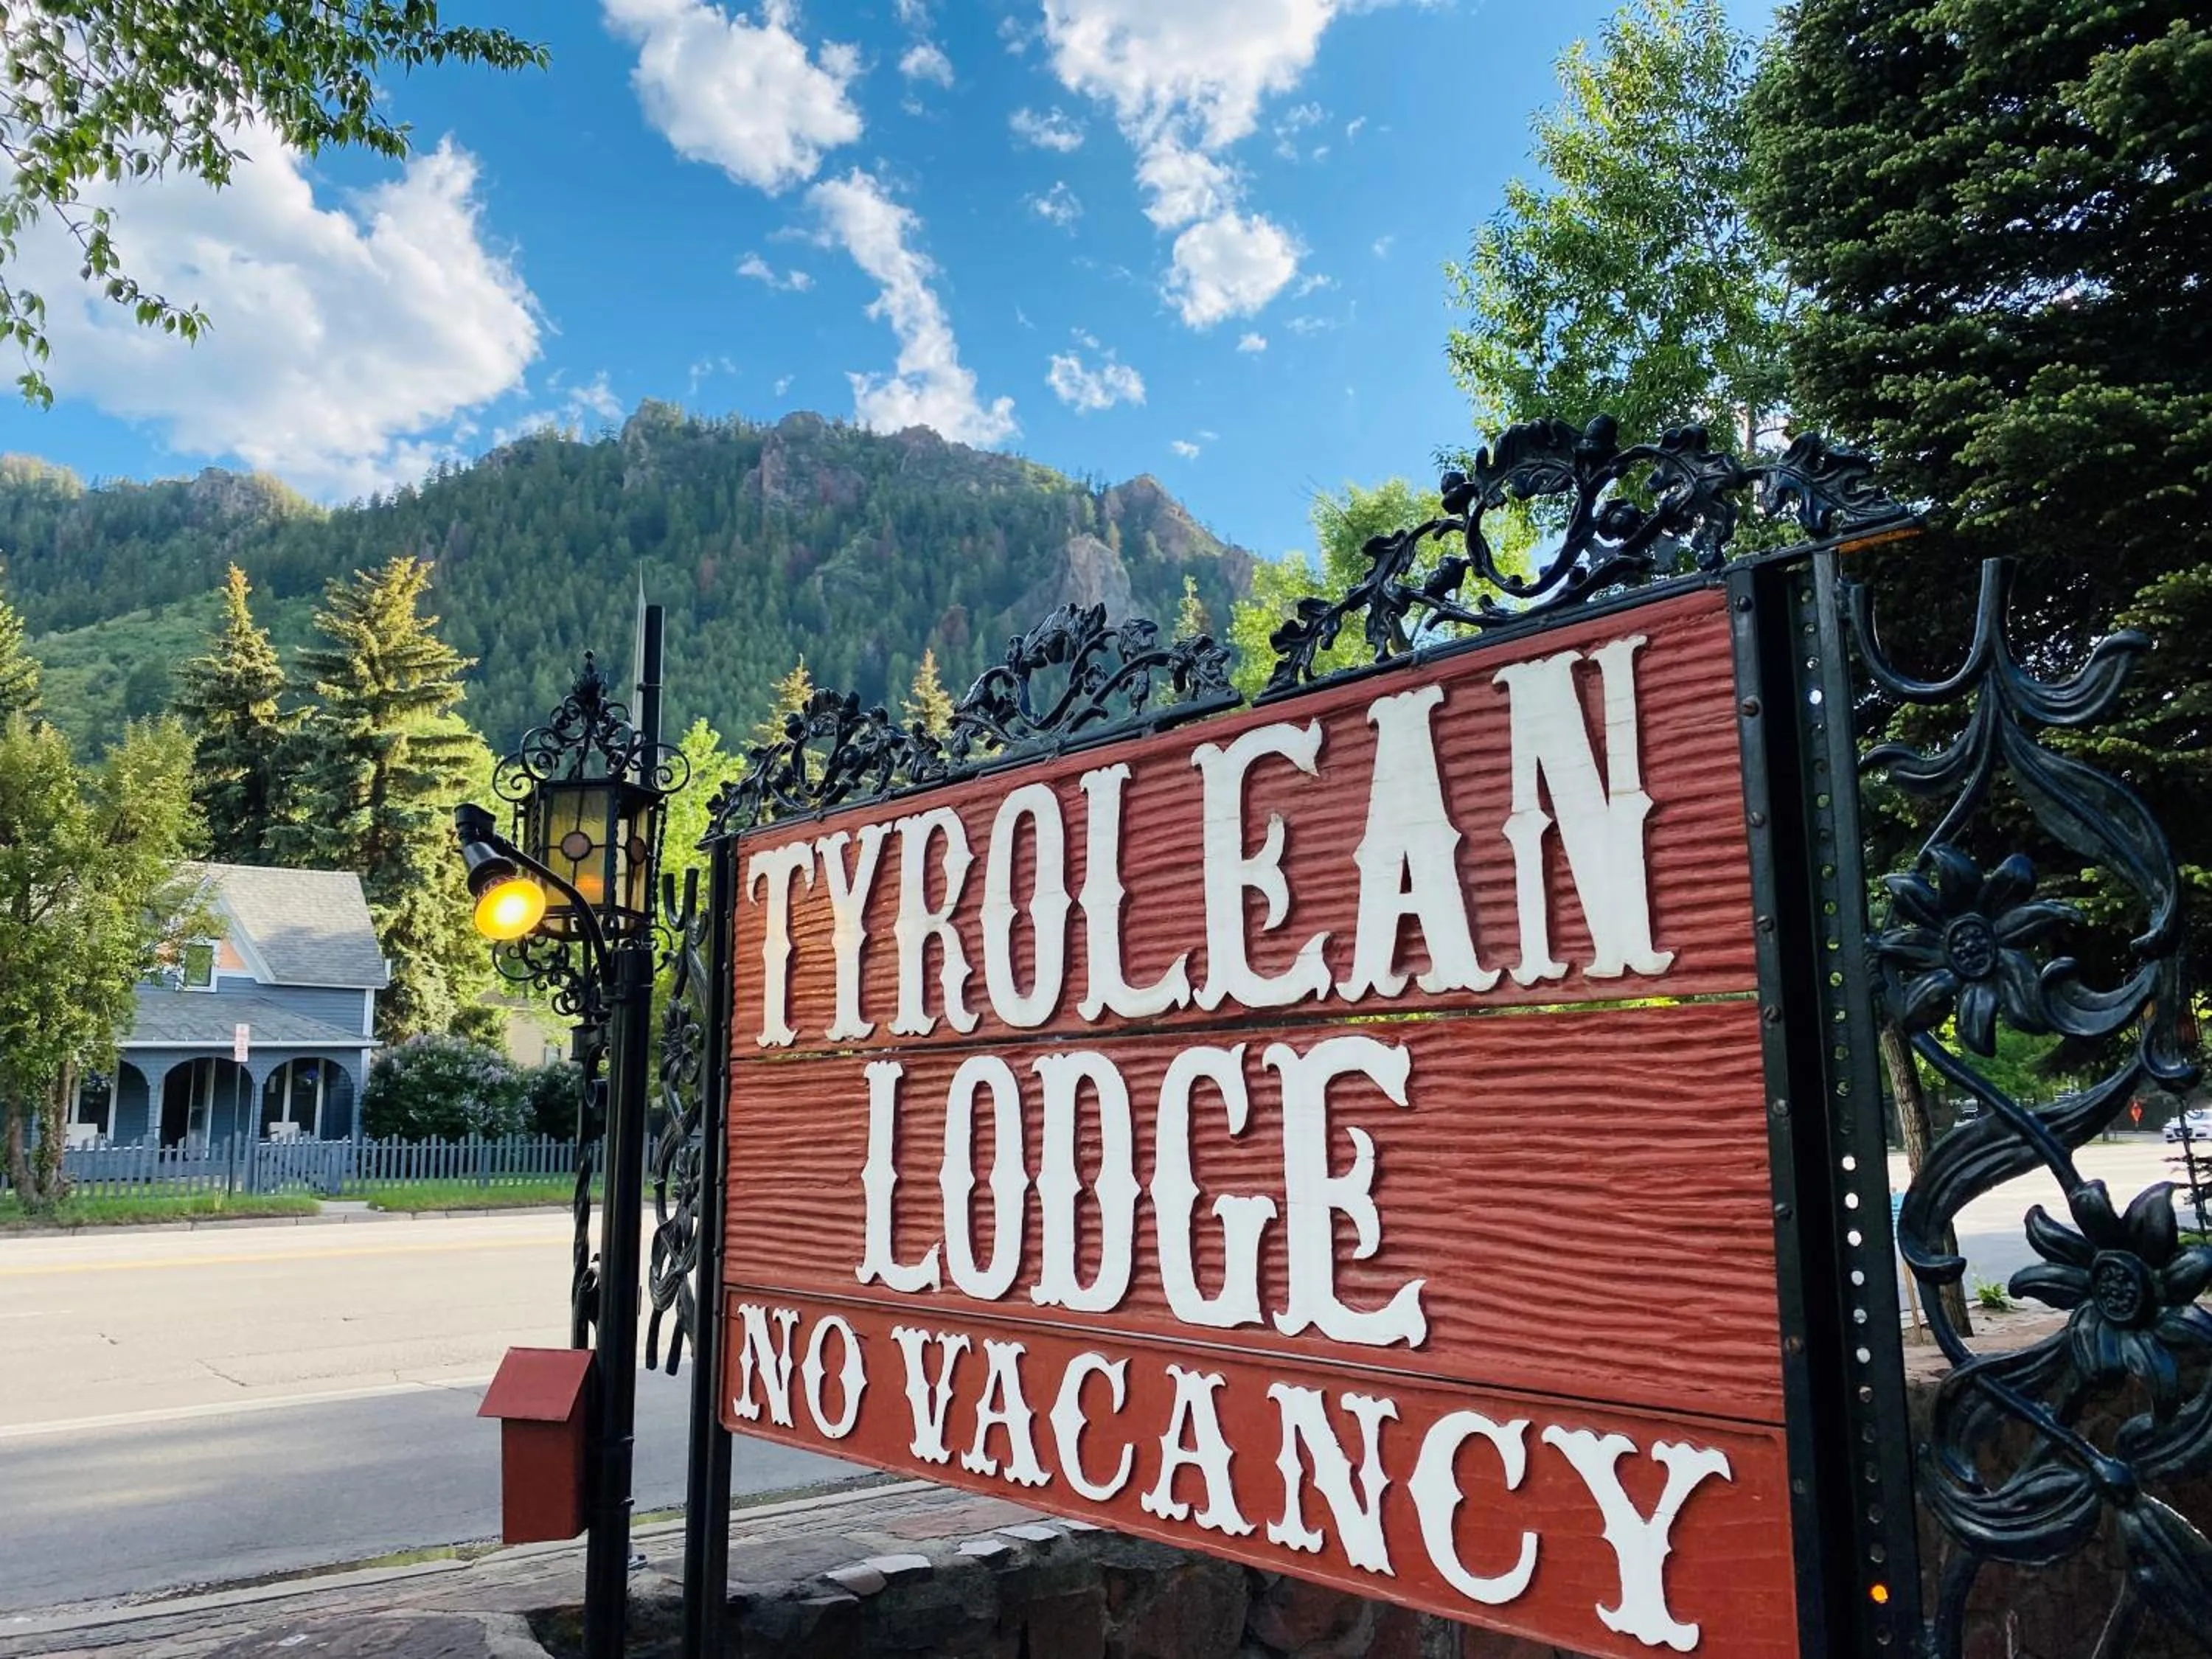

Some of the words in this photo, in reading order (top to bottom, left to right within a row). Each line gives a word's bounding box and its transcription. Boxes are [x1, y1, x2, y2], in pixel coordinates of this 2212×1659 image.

[746, 634, 1676, 1048] TYROLEAN
[855, 1036, 1427, 1349] LODGE
[733, 1304, 869, 1439] NO
[891, 1326, 1733, 1652] VACANCY
